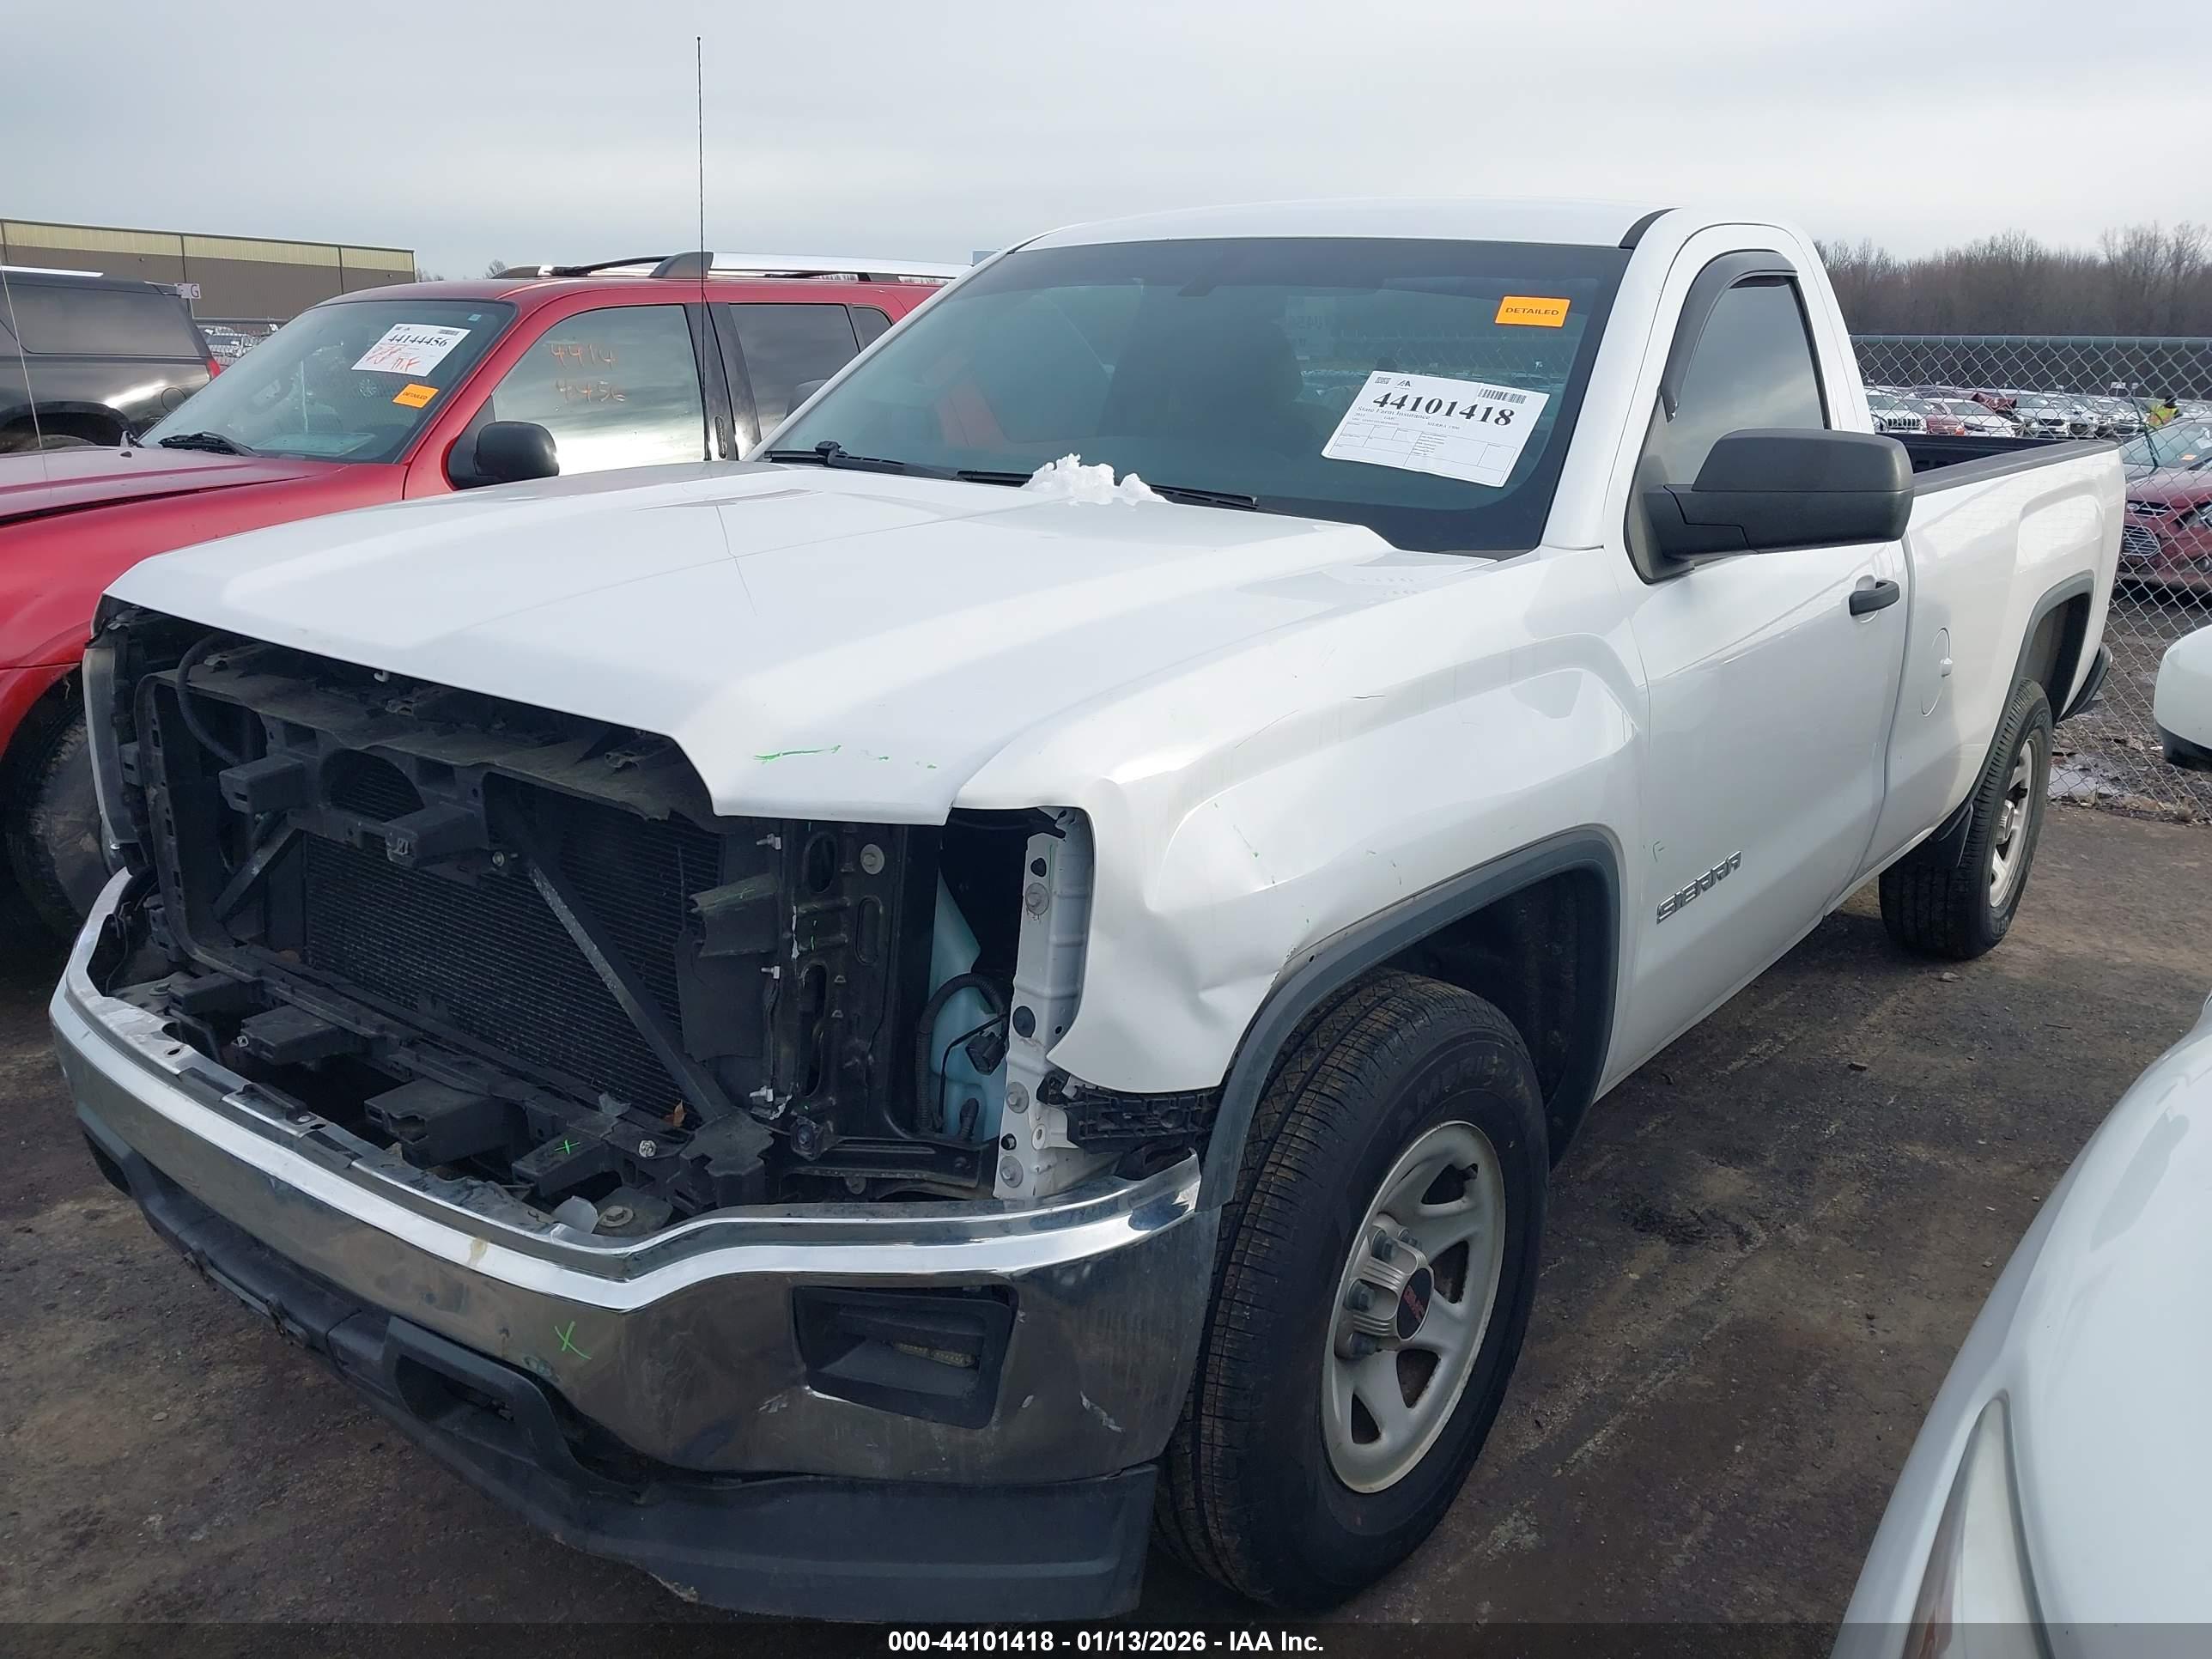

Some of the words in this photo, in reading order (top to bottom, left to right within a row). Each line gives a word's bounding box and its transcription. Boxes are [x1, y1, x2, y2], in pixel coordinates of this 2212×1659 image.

[388, 333, 447, 348] 44144456
[1372, 392, 1516, 426] 44101418
[1396, 410, 1431, 420] Insurance
[1656, 850, 1741, 925] SIERRA
